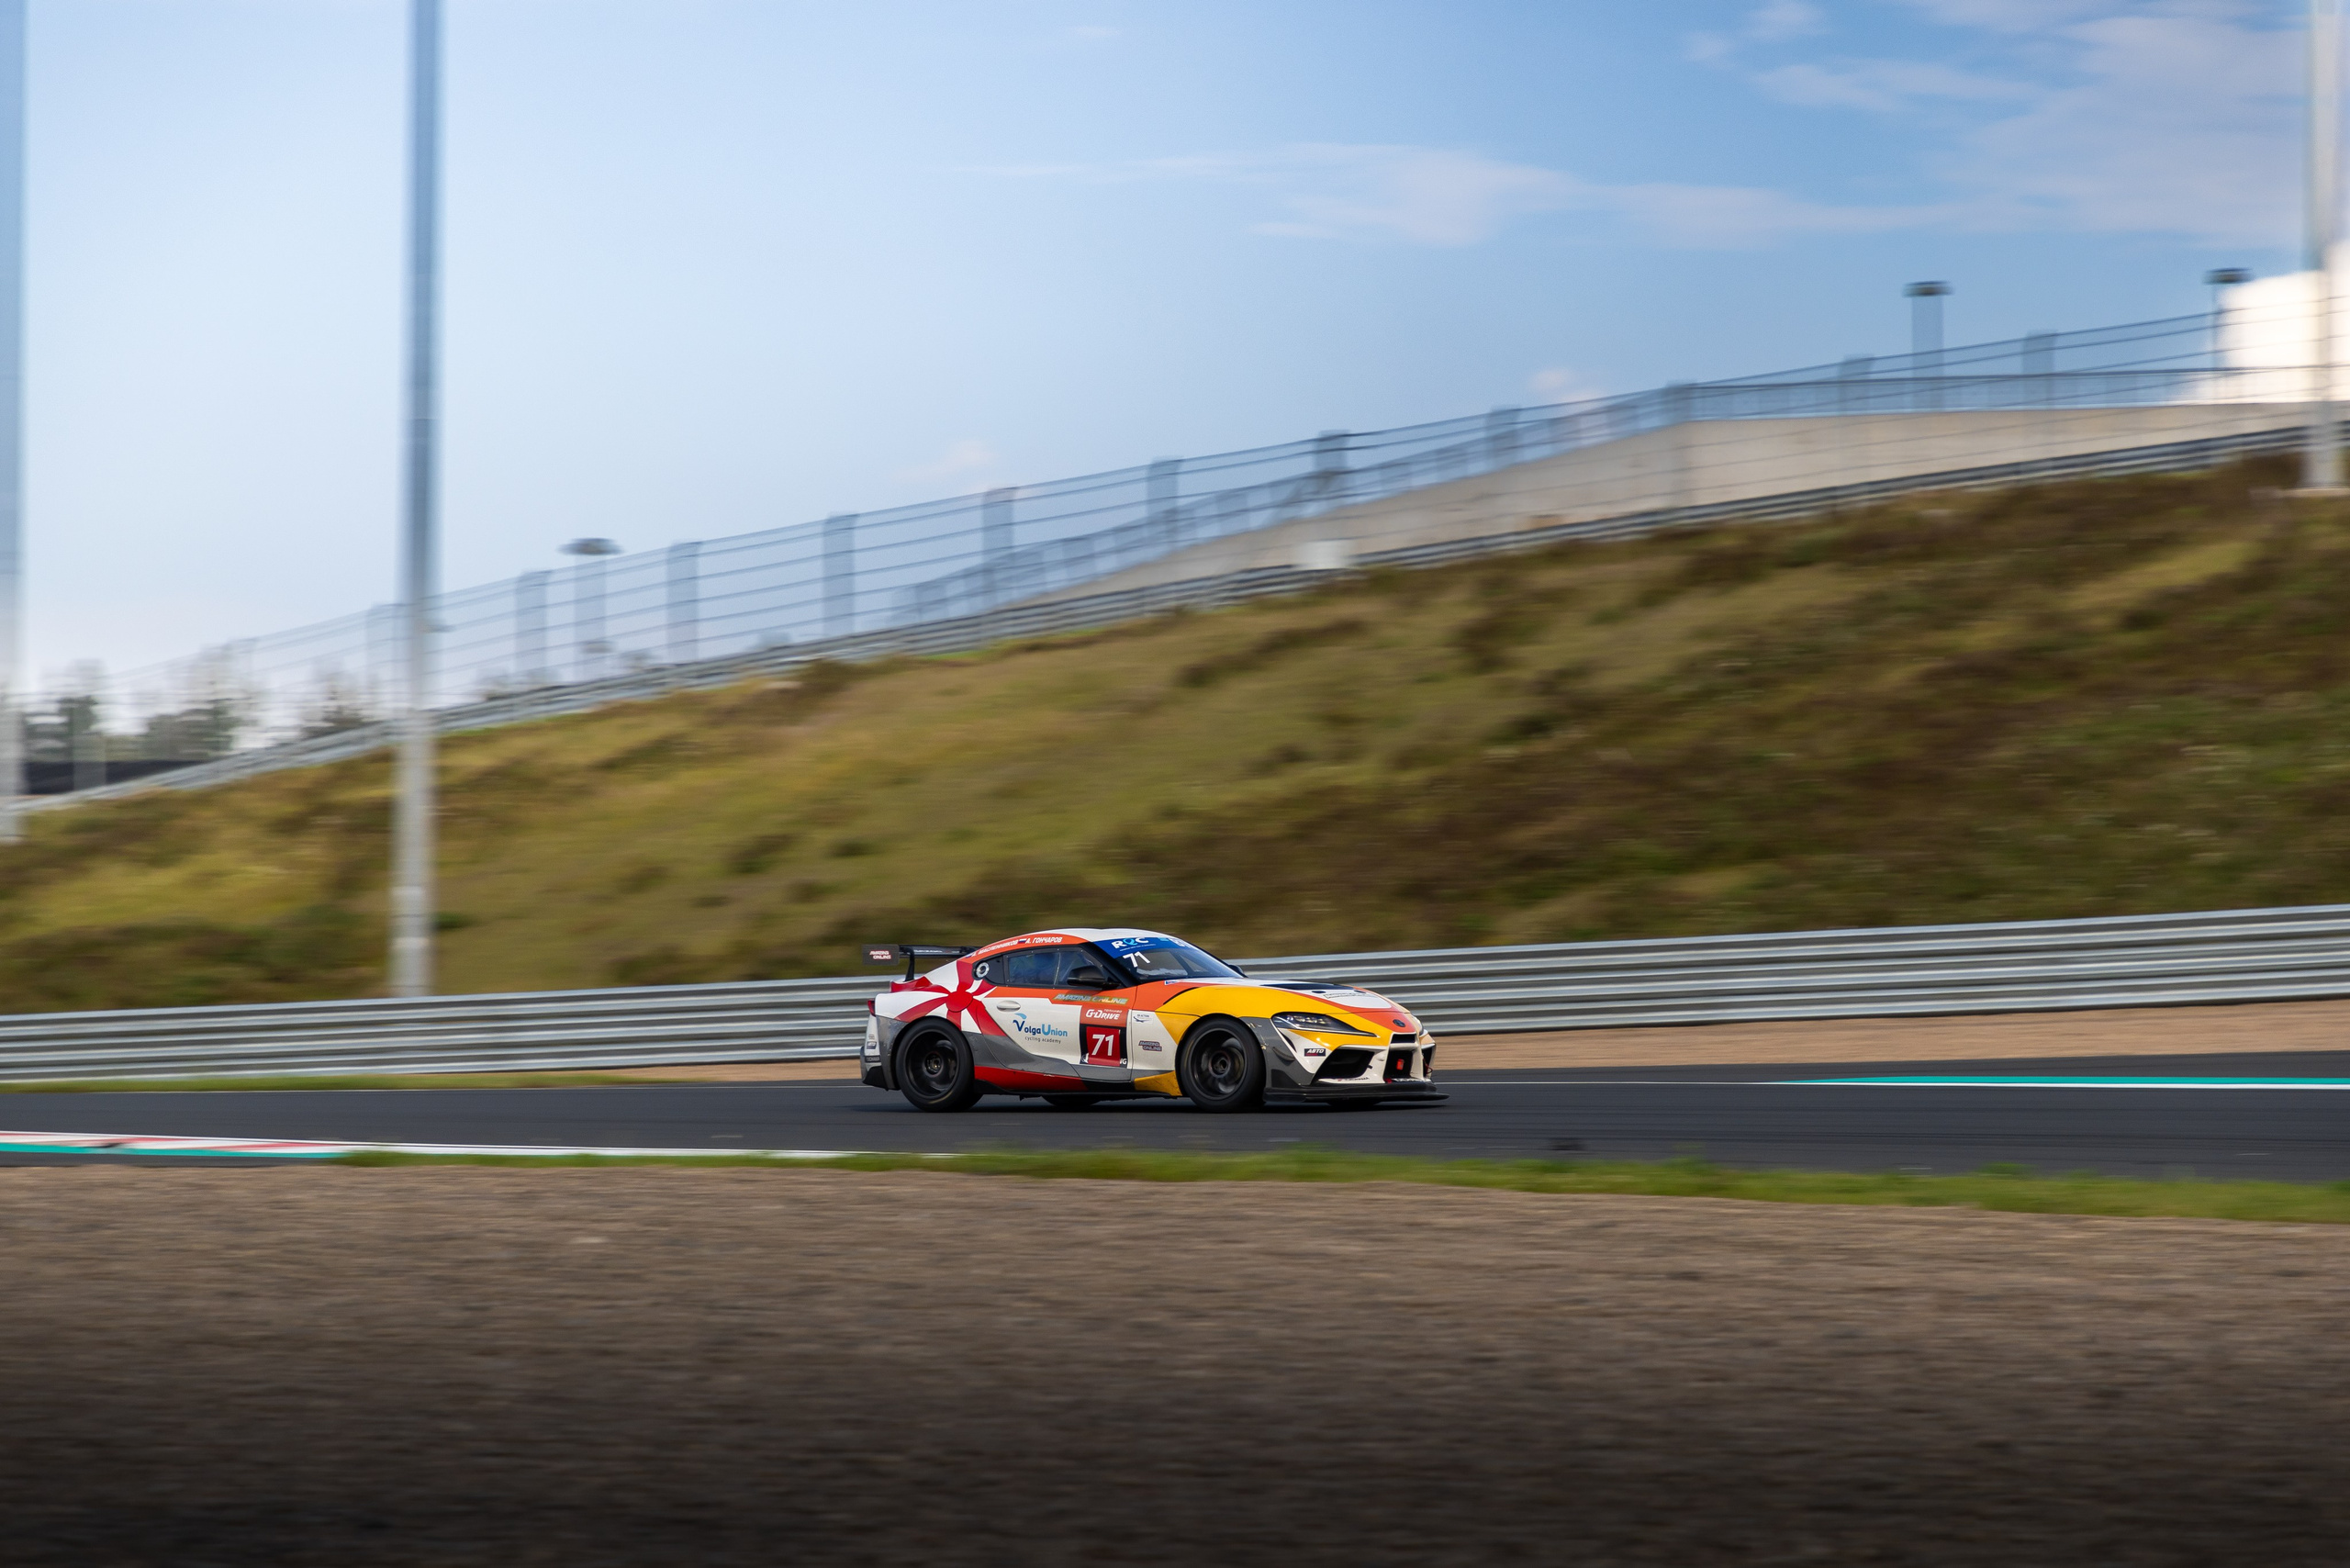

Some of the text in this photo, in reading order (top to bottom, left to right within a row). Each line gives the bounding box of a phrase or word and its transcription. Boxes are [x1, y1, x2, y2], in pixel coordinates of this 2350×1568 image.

[1123, 951, 1150, 968] 71
[1091, 995, 1128, 1005] ONLINE
[1091, 1034, 1114, 1057] 71
